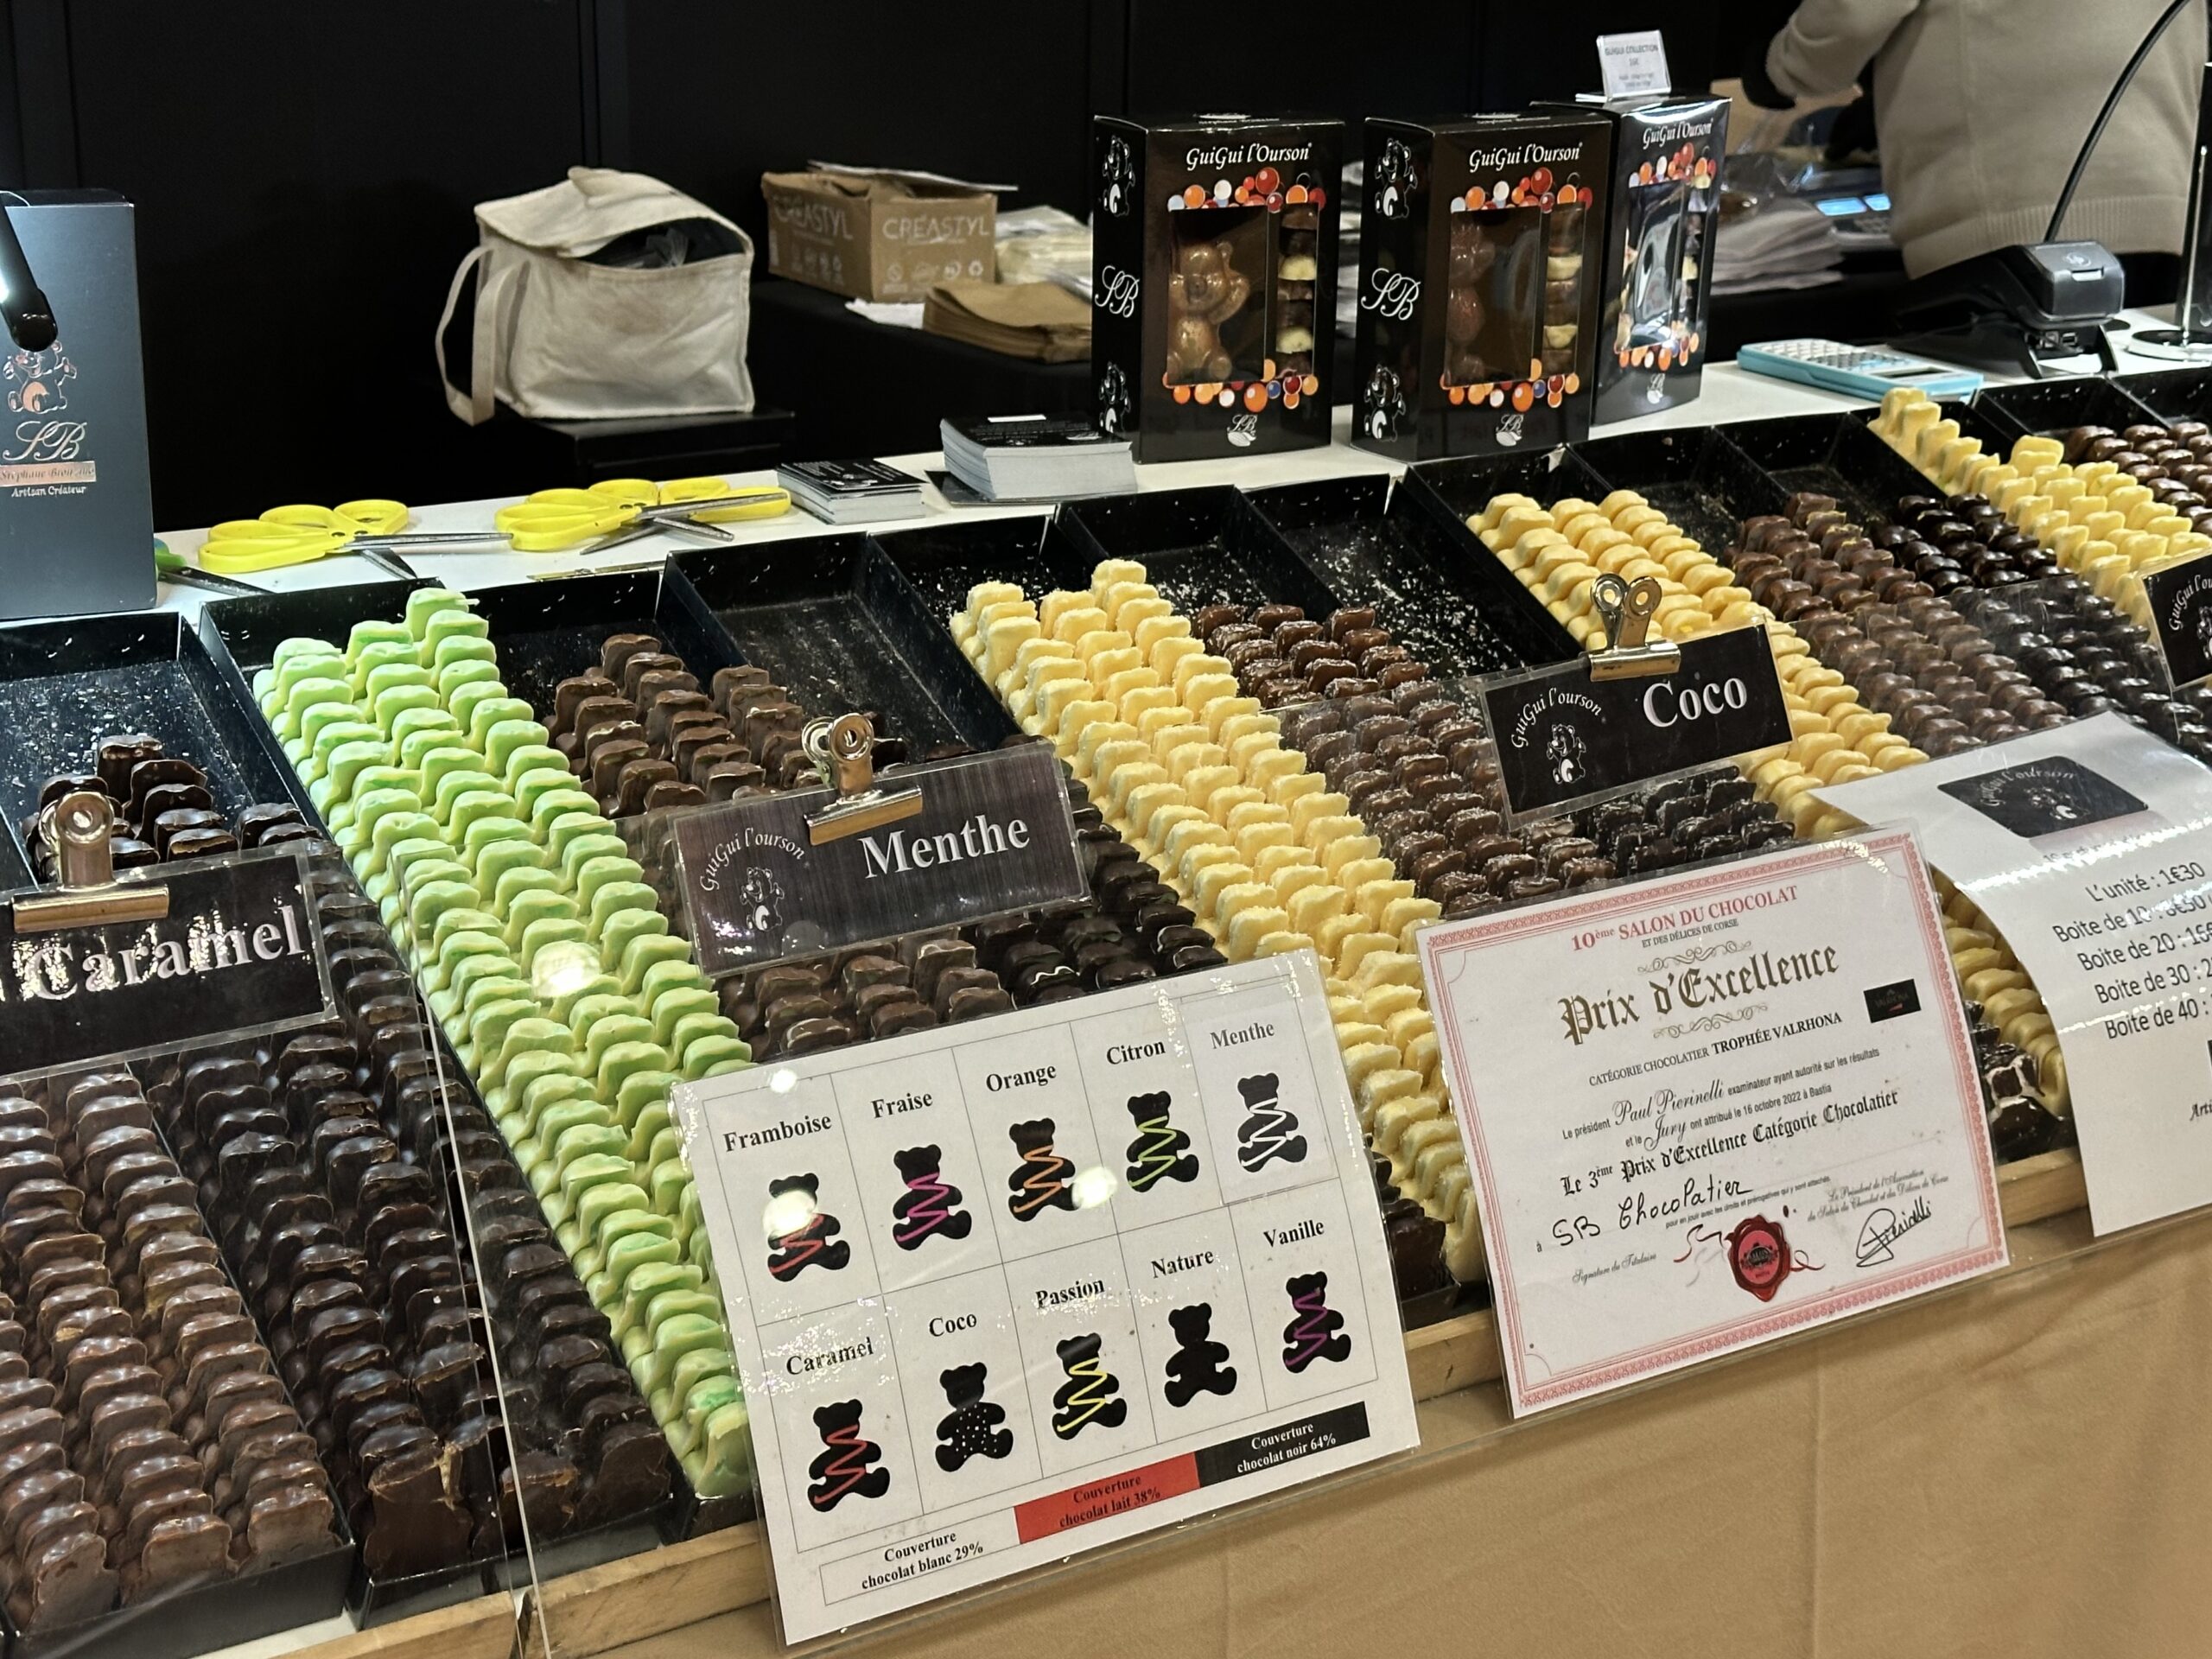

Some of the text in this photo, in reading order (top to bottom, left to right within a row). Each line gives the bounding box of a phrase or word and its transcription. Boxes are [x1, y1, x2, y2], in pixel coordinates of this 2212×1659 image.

[1643, 124, 1676, 150] GuiGui
[1185, 145, 1244, 171] GuiGui
[1469, 146, 1522, 173] GuiGui
[2169, 580, 2195, 631] GuiGui
[1510, 687, 1602, 748] GuiGui l'ourson
[1643, 677, 1748, 728] Coco
[699, 827, 805, 892] GuiGui l'ourson
[858, 814, 1031, 880] Menthe
[2085, 874, 2151, 902] L'unité
[2158, 861, 2206, 886] 1€30
[1571, 885, 1798, 951] 10ème SALON DU CHOCOLAT
[1642, 938, 1653, 948] ET
[1653, 934, 1669, 945] DES
[1702, 924, 1714, 935] DE
[1714, 918, 1739, 932] CORSE
[2052, 920, 2103, 943] Boite
[2103, 912, 2127, 931] de
[24, 905, 305, 1001] Caramel
[2077, 948, 2126, 971] Boite
[2128, 940, 2152, 960] de
[2150, 932, 2176, 954] 20
[1557, 945, 1840, 1046] Prix d'Excellence
[2094, 978, 2142, 1004] Boite
[2144, 970, 2166, 992] de
[2166, 964, 2190, 986] 30
[1210, 1021, 1275, 1050] Menthe
[2105, 1014, 2151, 1039] Boite
[2153, 1006, 2175, 1027] de
[2178, 998, 2199, 1021] 40
[1106, 1039, 1166, 1066] Citron
[1588, 1011, 1843, 1087] CATÉGORIE CHOCOLATIER TROPHÉE VALRHONA
[985, 1064, 1057, 1093] Orange
[1562, 1129, 1573, 1140] Le
[1574, 1118, 1611, 1138] président
[1611, 1096, 1653, 1126] Paul
[1728, 1077, 1772, 1096] examinateur
[1773, 1070, 1795, 1084] ayant
[1795, 1061, 1822, 1078] autorité
[1823, 1059, 1835, 1071] sur
[1836, 1056, 1848, 1067] les
[871, 1091, 934, 1120] Fraise
[1625, 1136, 1633, 1147] et
[1634, 1134, 1643, 1145] le
[1643, 1114, 1687, 1153] Jury
[1690, 1120, 1703, 1130] ont
[1733, 1108, 1742, 1119] le
[1743, 1104, 1753, 1116] 16
[1754, 1098, 1782, 1114] octobre
[1783, 1090, 1802, 1105] 2022
[1809, 1083, 1833, 1098] Bastia
[723, 1113, 833, 1153] Framboise
[1560, 1175, 1582, 1197] Le
[1620, 1156, 1656, 1183] Prix
[1661, 1131, 1748, 1168] d'Excellence
[1752, 1111, 1819, 1143] Catégorie
[1823, 1089, 1899, 1125] Chocolatier
[1263, 1218, 1325, 1249] Vanille
[1552, 1216, 1601, 1247] SB
[1150, 1249, 1215, 1280] Nature
[1035, 1277, 1106, 1309] Passion
[928, 1313, 977, 1338] Coco
[785, 1337, 874, 1376] Caramel
[1236, 1433, 1337, 1474] chocolat noir 64%
[1250, 1421, 1315, 1452] Couverture
[1072, 1473, 1142, 1504] Couverture
[1058, 1503, 1109, 1529] chocolat
[1110, 1493, 1131, 1515] lait
[861, 1541, 984, 1590] chocolat blanc 29%
[884, 1530, 957, 1563] Couverture
